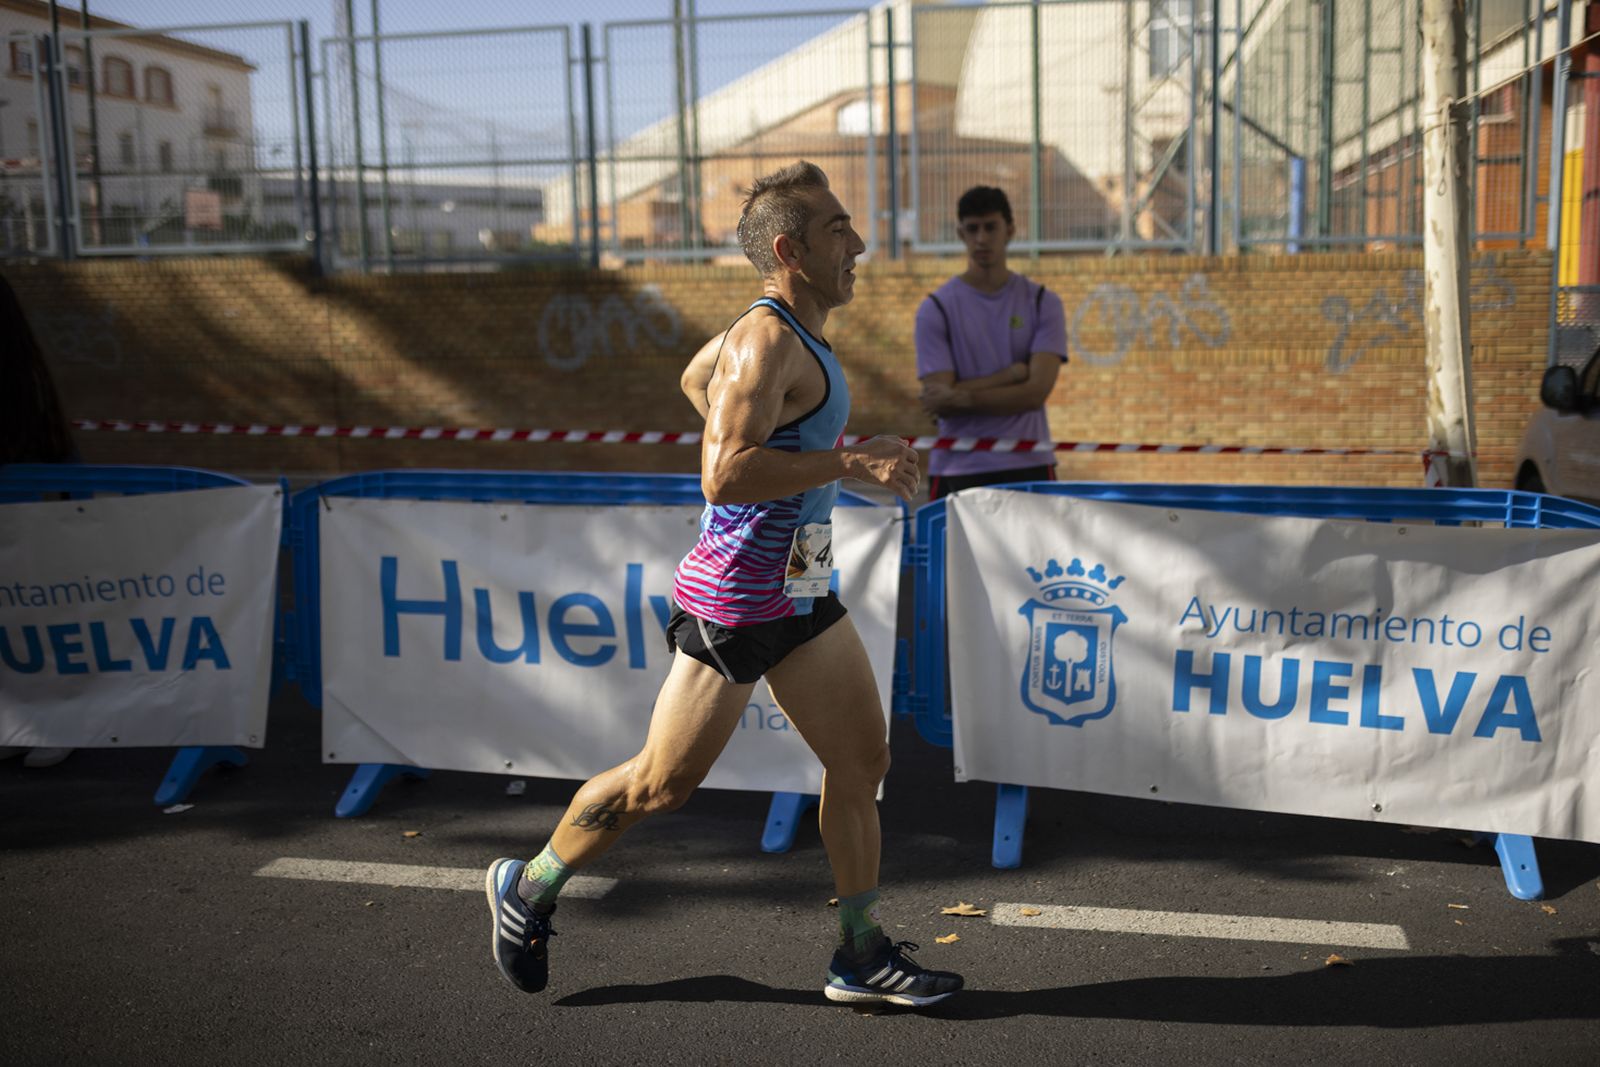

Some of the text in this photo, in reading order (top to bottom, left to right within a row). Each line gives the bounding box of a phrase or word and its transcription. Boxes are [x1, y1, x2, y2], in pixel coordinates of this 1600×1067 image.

[186, 566, 225, 596] de
[815, 539, 833, 568] 4
[381, 556, 839, 670] Huel
[1179, 596, 1552, 653] Ayuntamiento de
[1172, 649, 1543, 743] HUELVA
